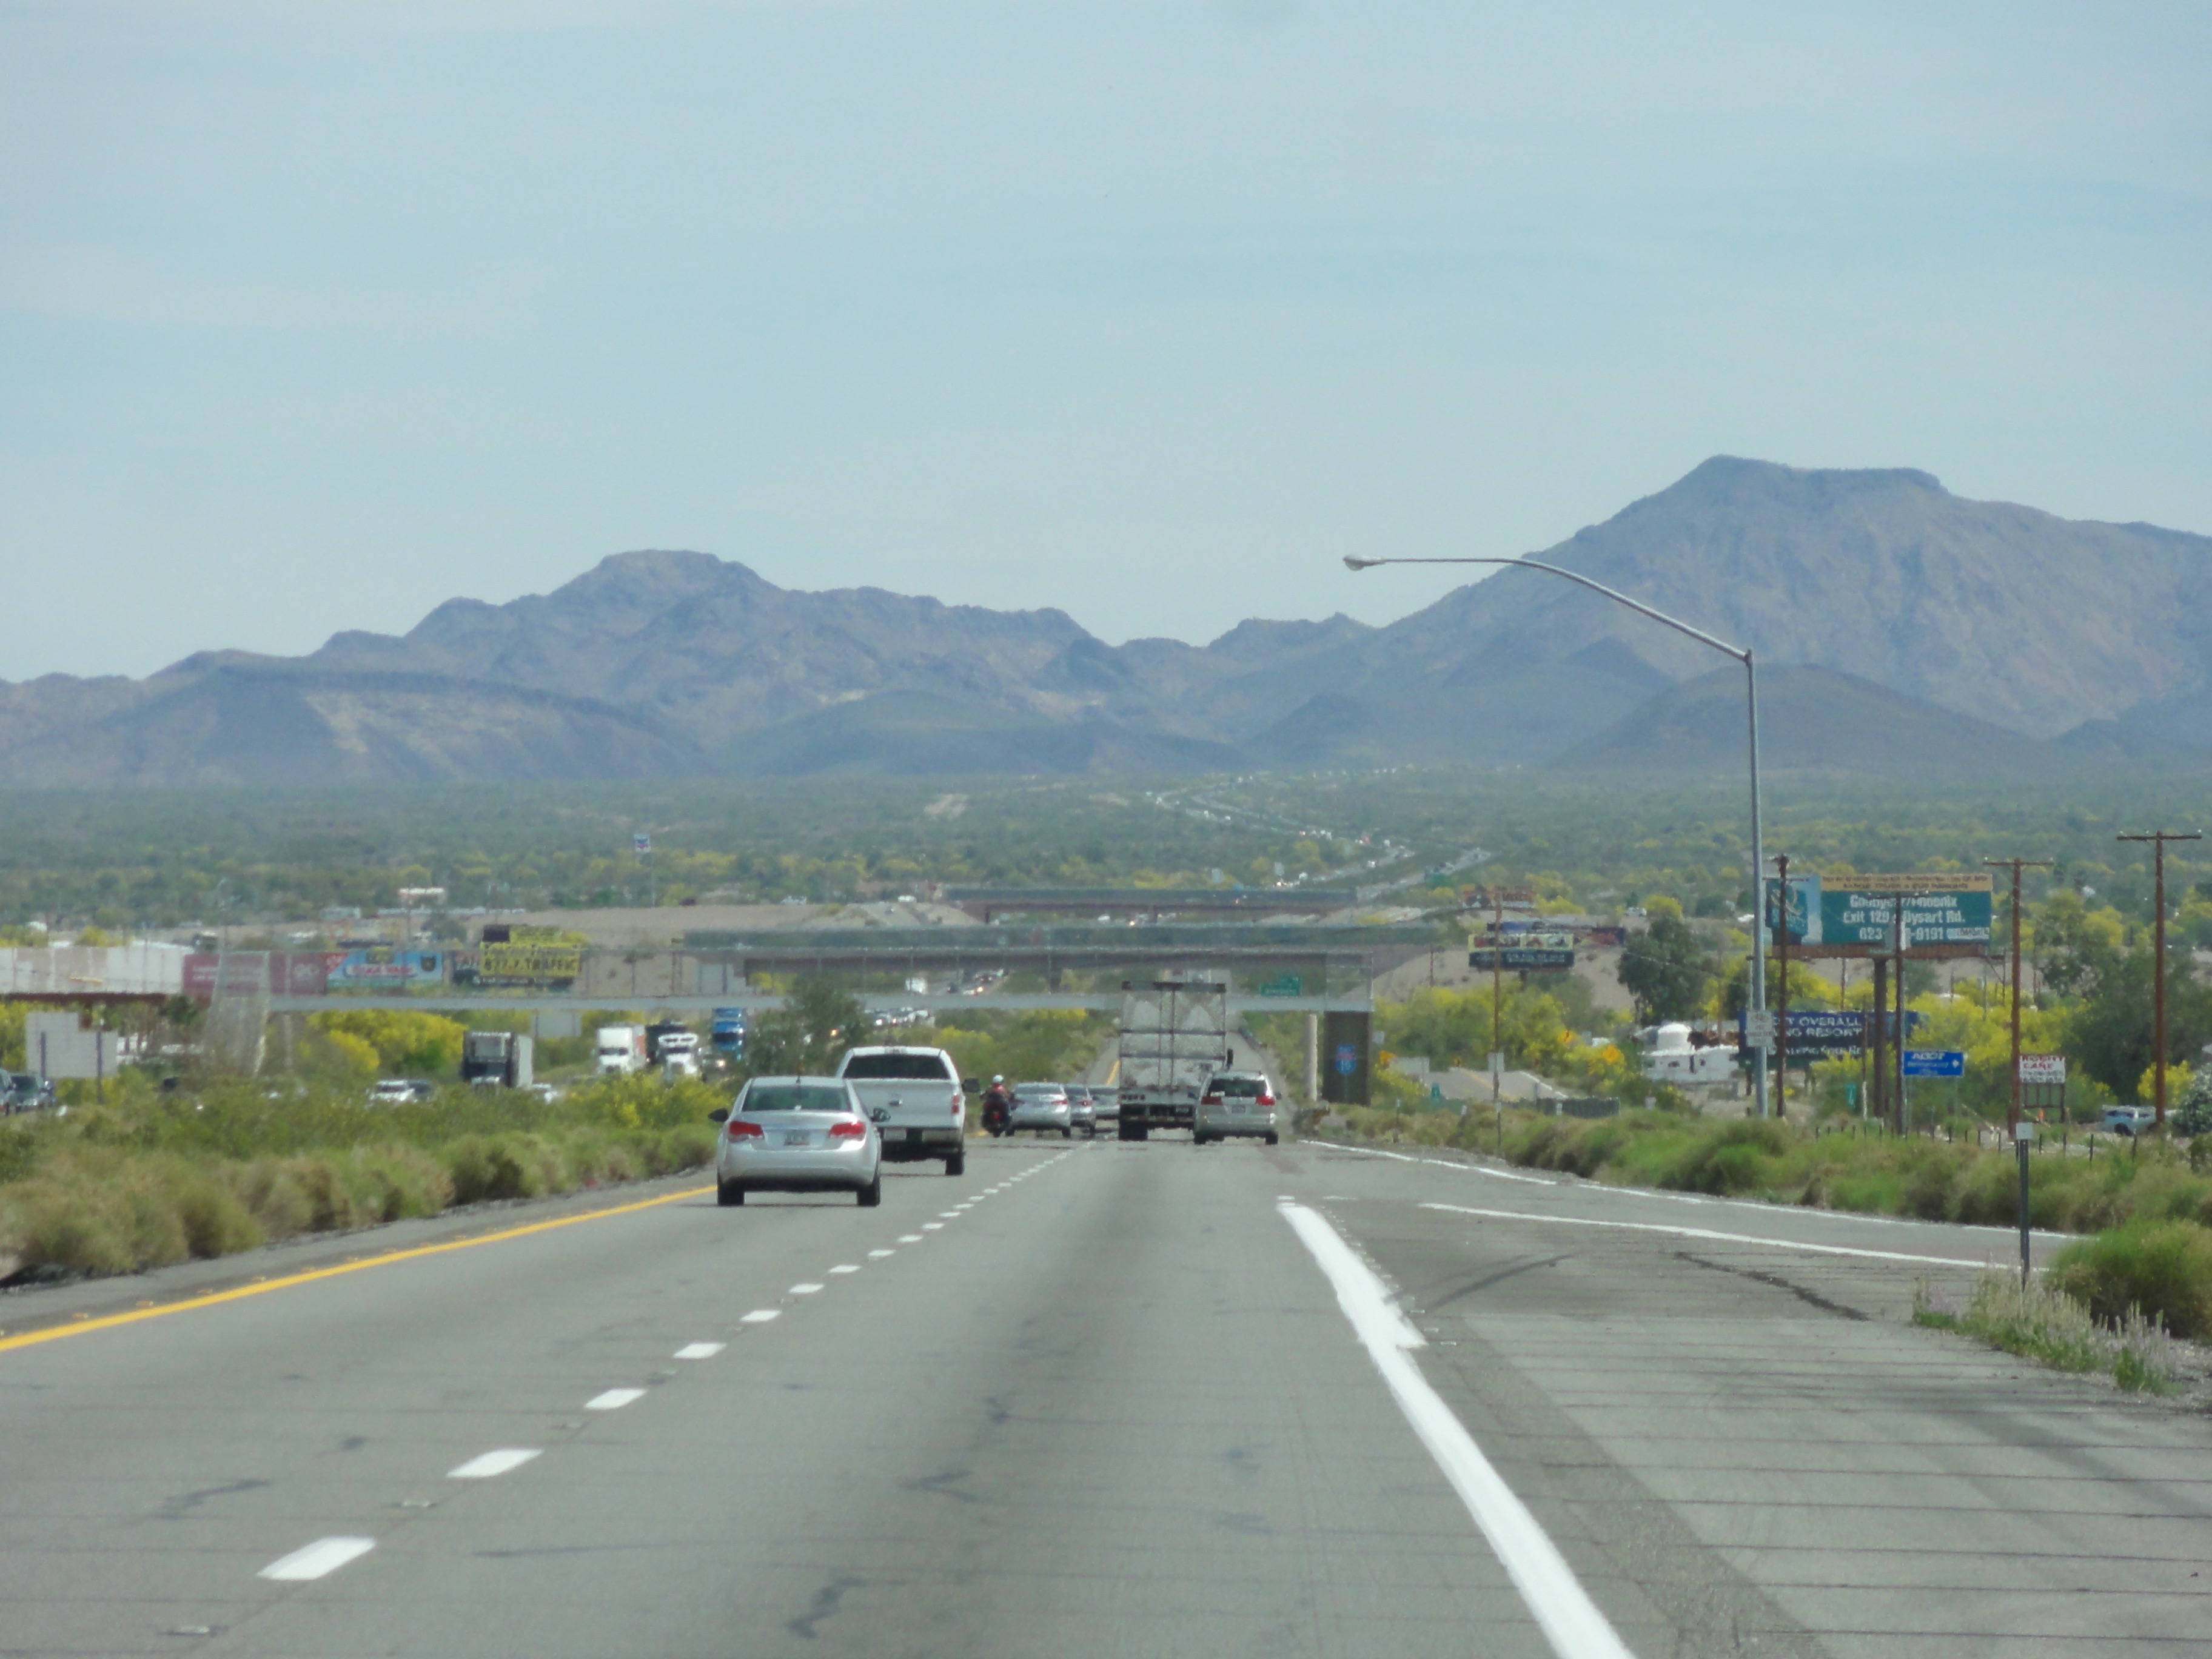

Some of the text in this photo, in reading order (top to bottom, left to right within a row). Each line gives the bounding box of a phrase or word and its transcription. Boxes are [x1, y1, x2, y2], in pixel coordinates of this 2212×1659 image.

[1843, 911, 1865, 923] Exit
[1799, 1016, 1862, 1027] OVERALL
[1806, 1028, 1863, 1037] RESORT
